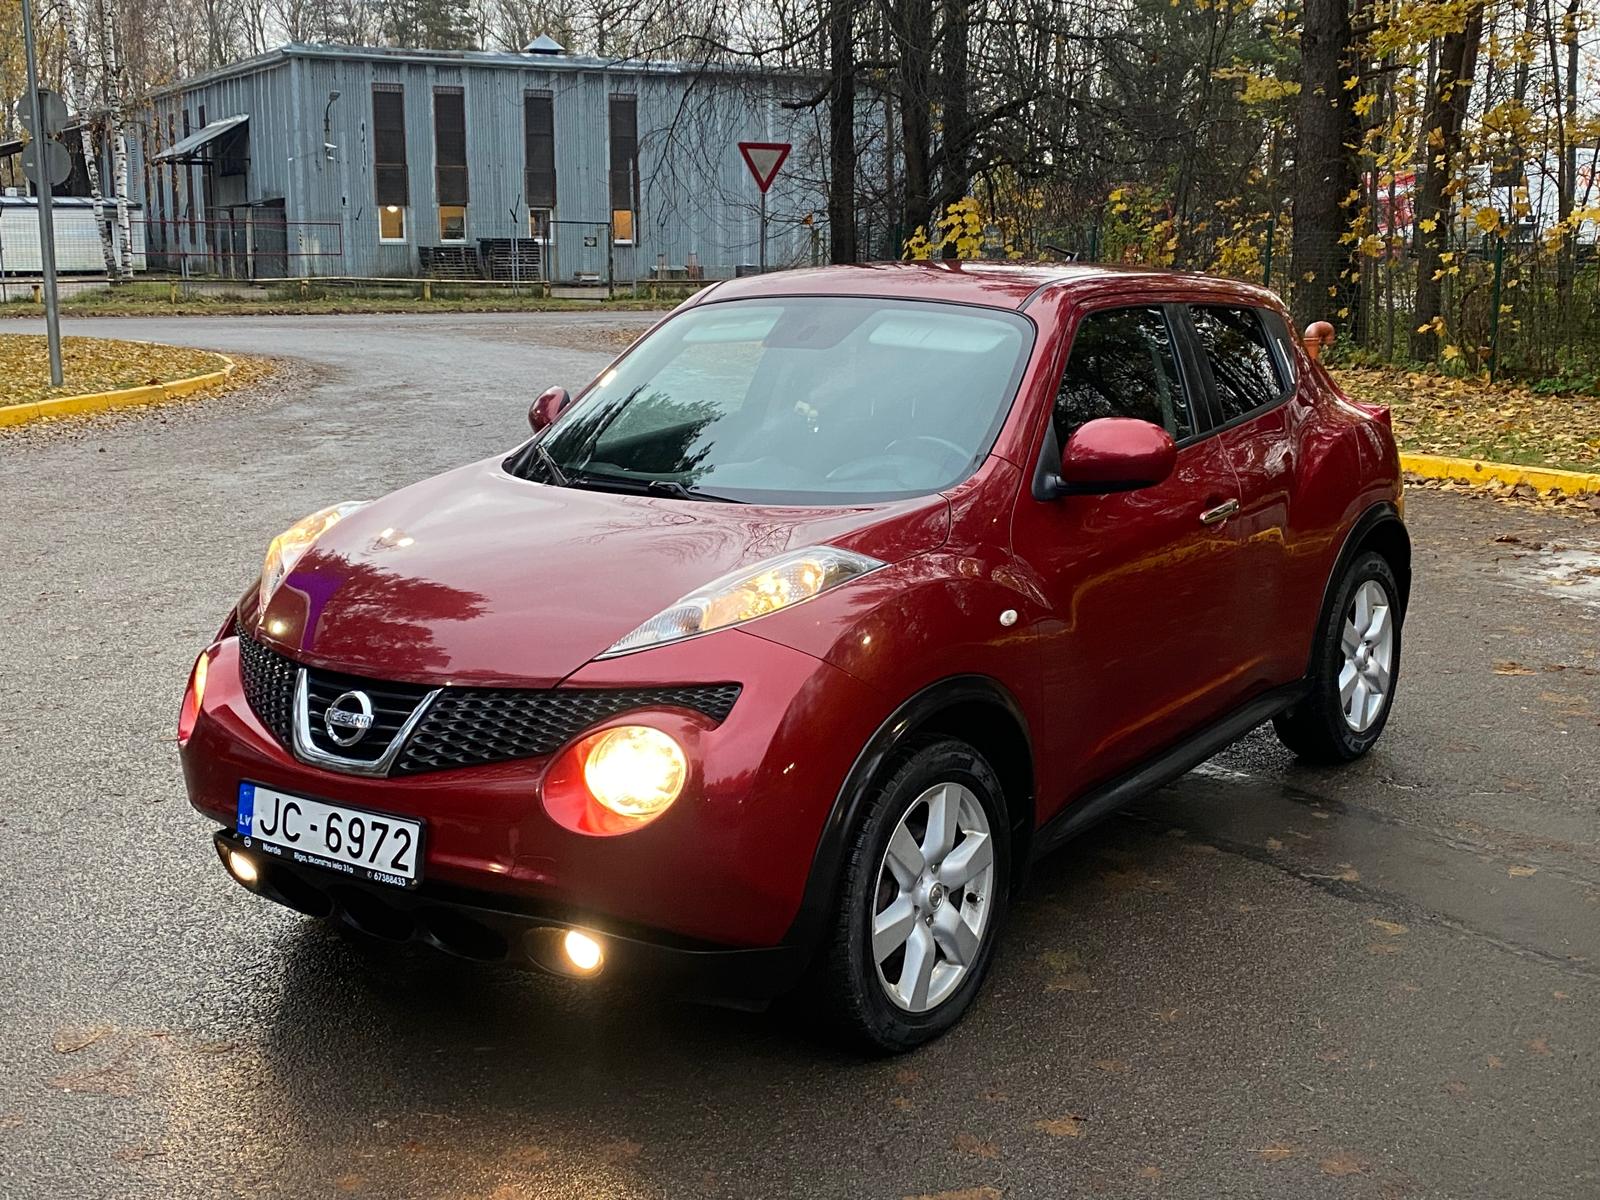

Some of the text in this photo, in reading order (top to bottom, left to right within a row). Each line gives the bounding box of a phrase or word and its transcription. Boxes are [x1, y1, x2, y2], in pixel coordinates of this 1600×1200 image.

[239, 814, 252, 826] LV
[259, 798, 411, 872] JC-6972
[262, 843, 282, 855] Norde
